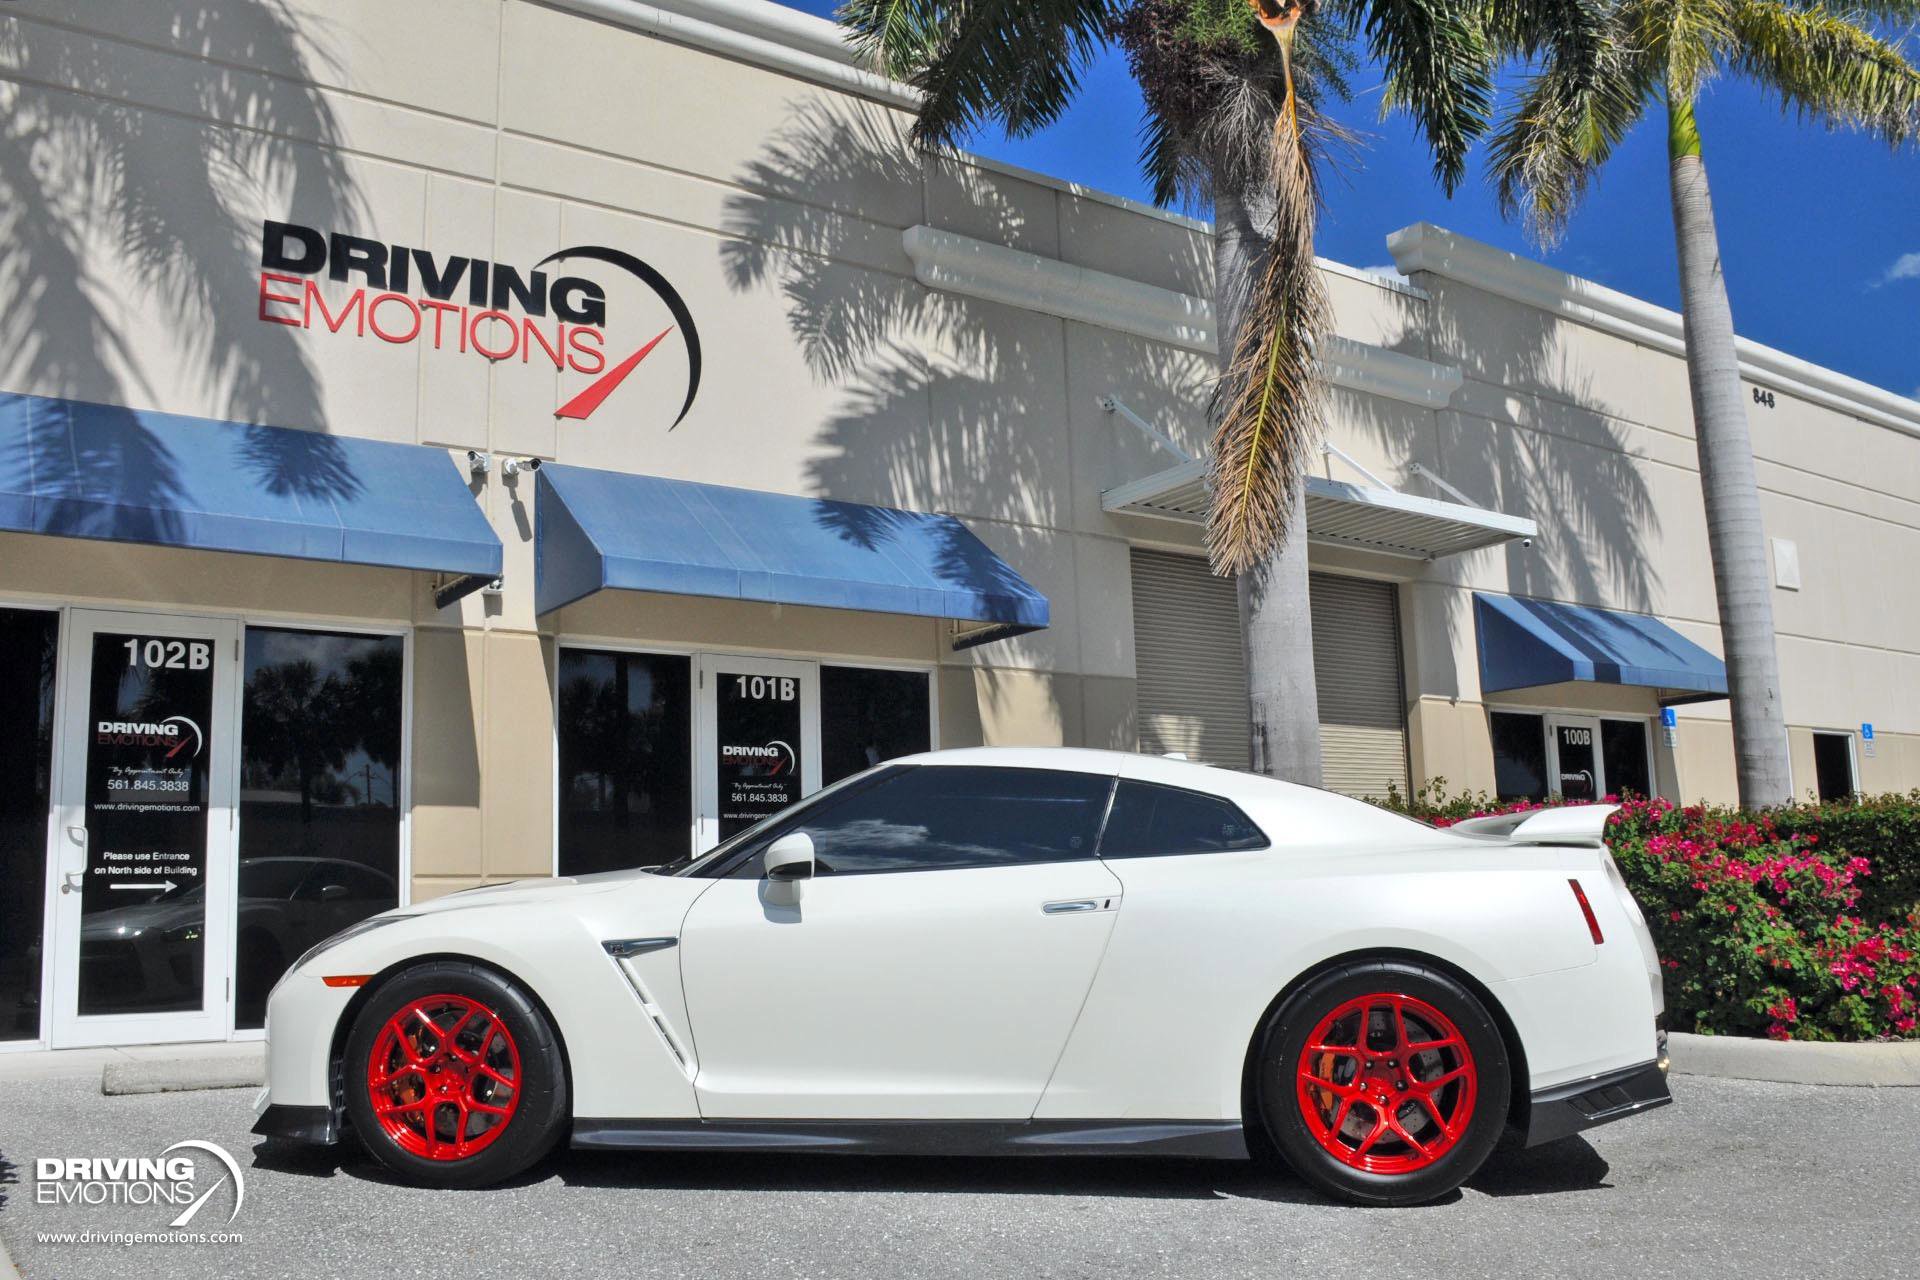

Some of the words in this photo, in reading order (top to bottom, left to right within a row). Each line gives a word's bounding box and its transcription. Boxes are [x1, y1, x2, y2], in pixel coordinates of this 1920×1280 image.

[261, 220, 606, 328] DRIVING
[259, 273, 606, 375] EMOTIONS
[1753, 387, 1775, 408] 848
[124, 639, 210, 670] 102B
[737, 675, 795, 701] 101B
[97, 721, 179, 736] DRIVING
[97, 733, 178, 746] EMOTIONS
[1564, 729, 1591, 745] 100B
[722, 745, 779, 757] DRIVING
[107, 779, 189, 792] 561.845.3838
[731, 793, 788, 803] 561.845.3838
[94, 802, 200, 813] www.drivingemotions.com
[103, 851, 133, 861] Please
[134, 853, 151, 861] use
[153, 851, 190, 861] Entrance
[94, 867, 106, 875] on
[108, 866, 132, 875] North
[134, 866, 152, 875] side
[153, 866, 163, 875] of
[164, 866, 198, 877] Building
